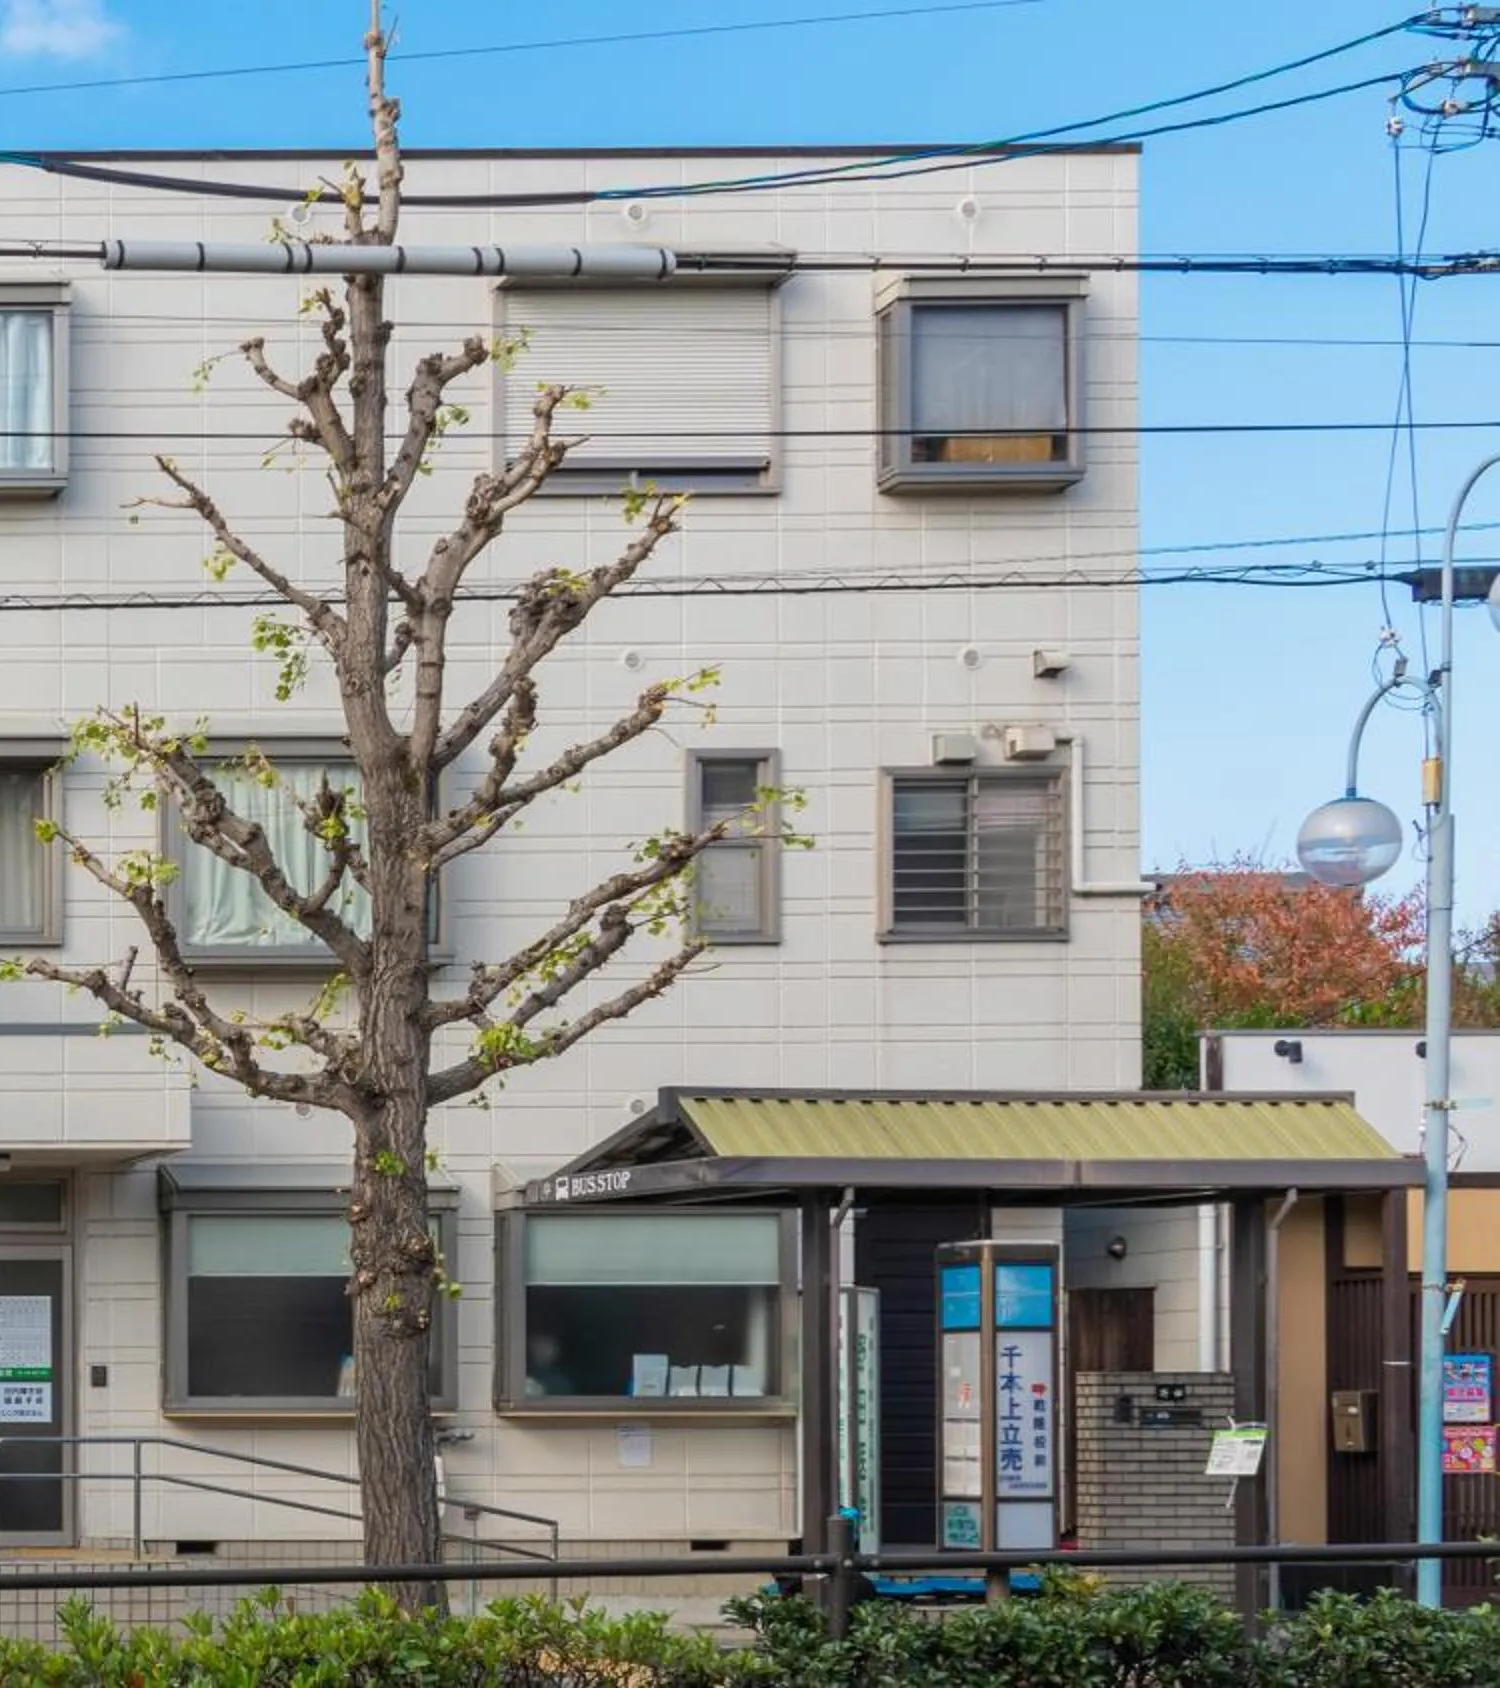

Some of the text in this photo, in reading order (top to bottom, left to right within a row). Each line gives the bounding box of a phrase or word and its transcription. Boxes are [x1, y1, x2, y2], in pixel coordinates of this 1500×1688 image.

[571, 1171, 632, 1197] BUS STOP
[999, 1346, 1024, 1472] 千本上立売
